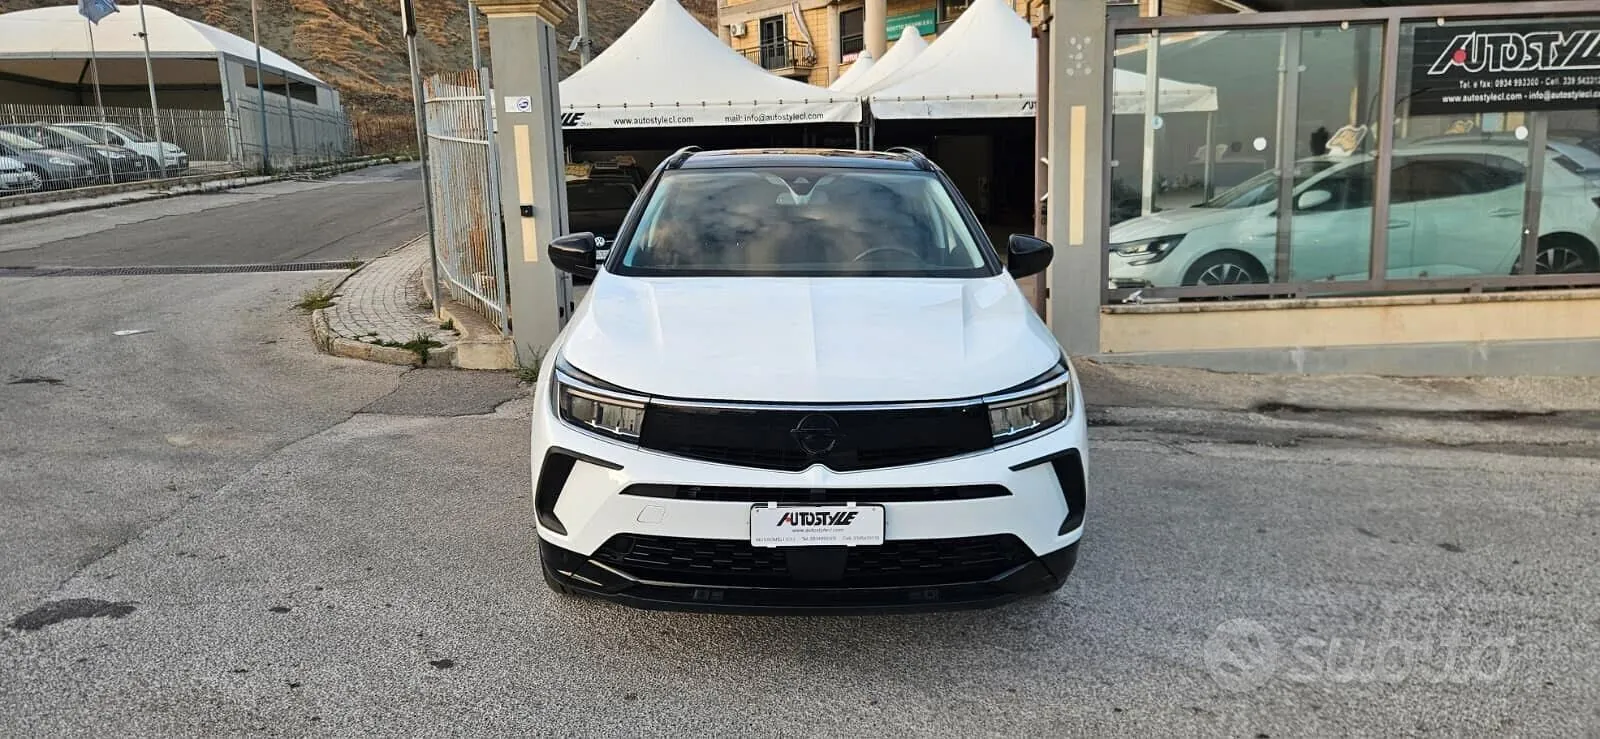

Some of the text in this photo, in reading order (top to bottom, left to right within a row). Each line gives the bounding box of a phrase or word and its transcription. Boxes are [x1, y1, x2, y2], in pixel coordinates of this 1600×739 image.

[1442, 92, 1522, 103] www.autostylecl.com
[613, 115, 694, 126] www.autostylecl.com
[744, 112, 824, 122] info@autostylecl.com
[776, 511, 859, 527] AUTOSTYLE
